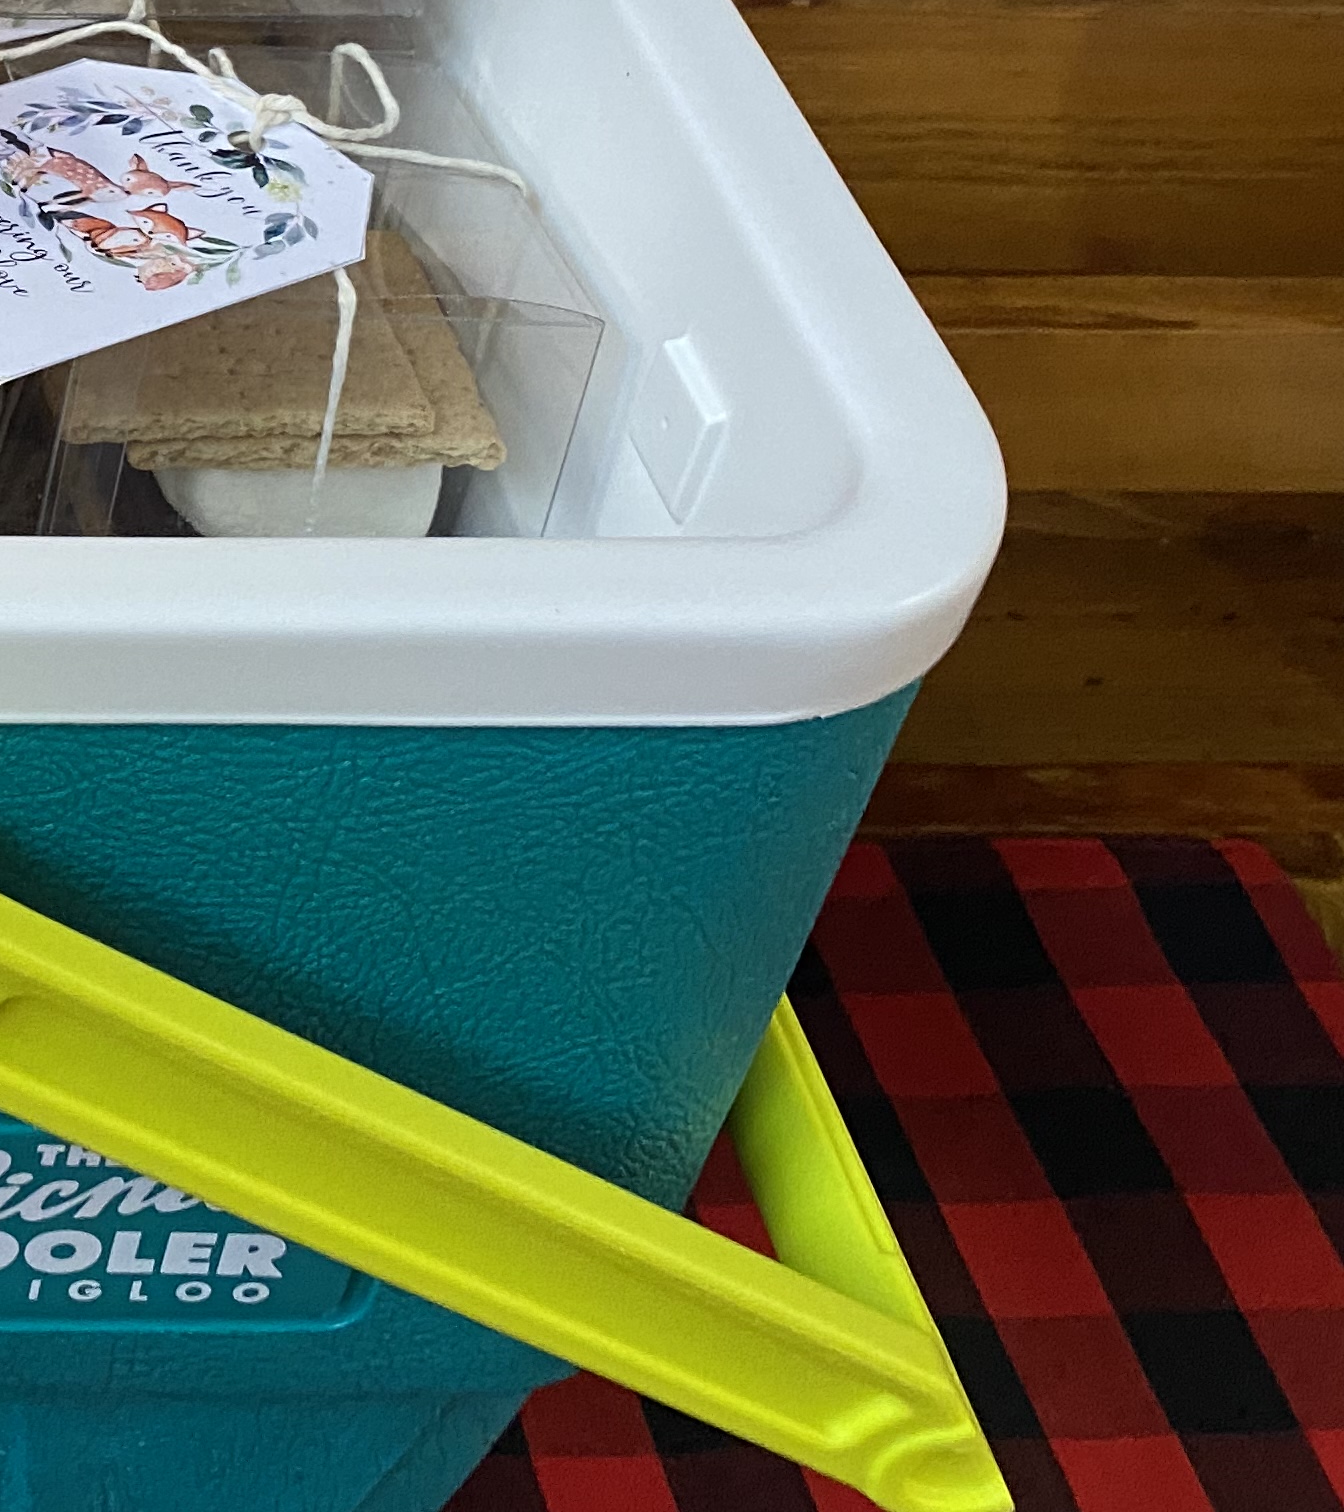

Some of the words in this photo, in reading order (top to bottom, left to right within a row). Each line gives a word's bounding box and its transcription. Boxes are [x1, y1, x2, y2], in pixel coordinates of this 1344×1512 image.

[138, 128, 235, 183] thank
[197, 178, 264, 220] you
[53, 262, 94, 293] our
[37, 1144, 129, 1167] TH
[28, 1279, 271, 1303] IGLOO
